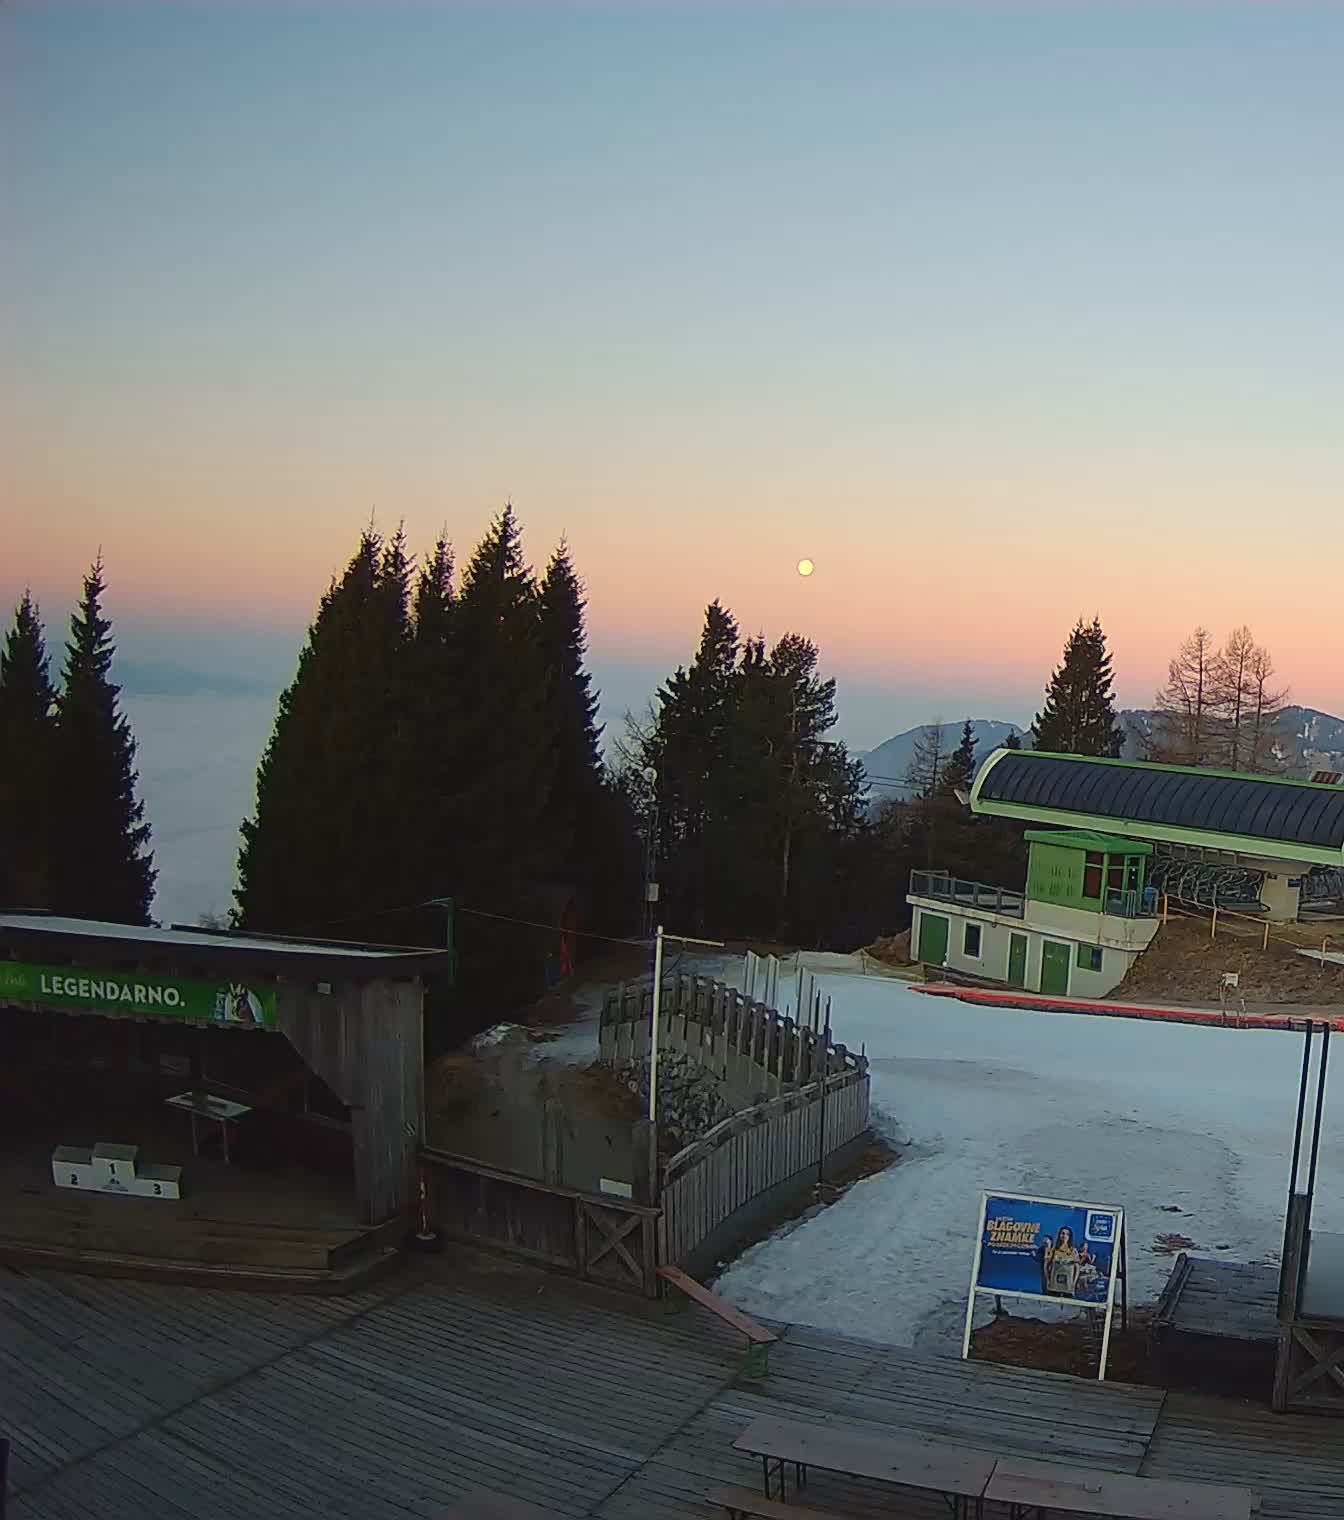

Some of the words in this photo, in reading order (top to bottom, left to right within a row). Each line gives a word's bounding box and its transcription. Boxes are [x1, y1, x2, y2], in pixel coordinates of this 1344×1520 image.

[41, 974, 186, 1007] LEGENDARNO.
[110, 1163, 115, 1174] 1
[71, 1174, 78, 1185] 2
[153, 1184, 162, 1194] 3
[986, 1220, 1040, 1232] BLAGOVNE
[990, 1231, 1035, 1243] ZNAMKE
